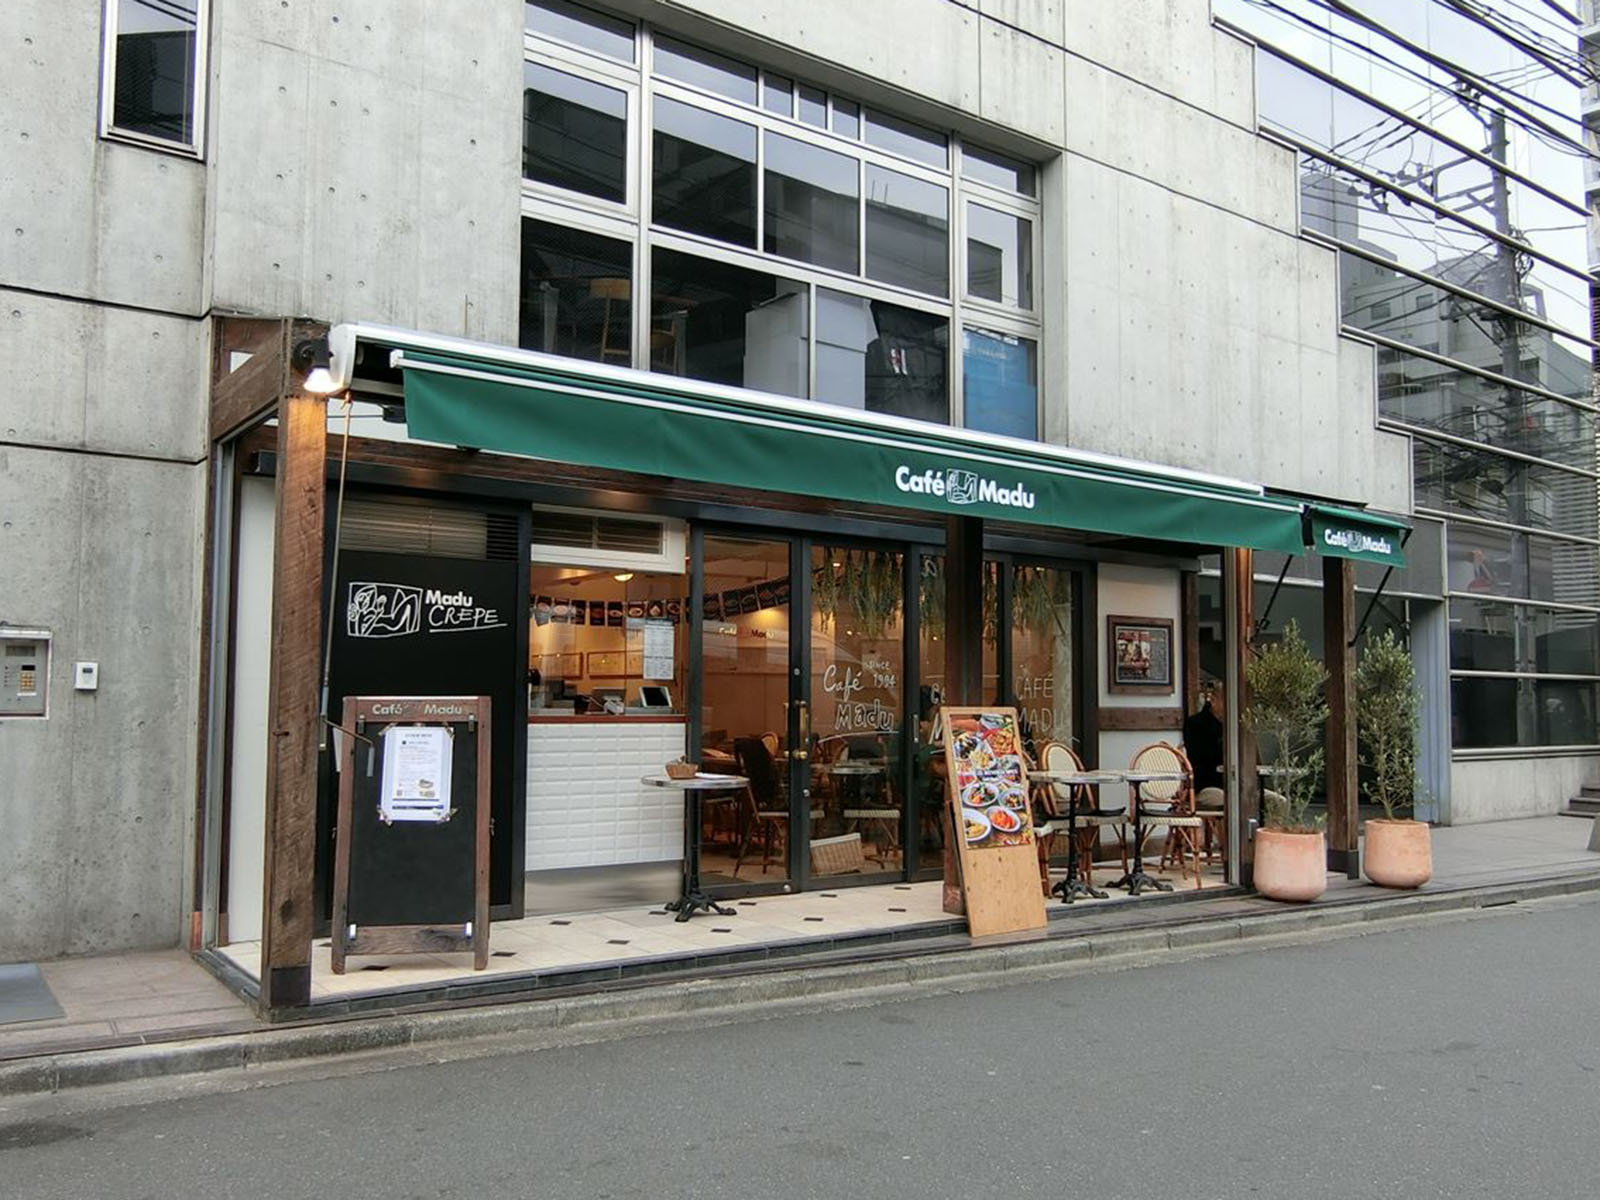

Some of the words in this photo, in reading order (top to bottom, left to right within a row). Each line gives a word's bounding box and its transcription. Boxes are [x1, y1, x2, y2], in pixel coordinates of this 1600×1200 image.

[895, 465, 945, 496] Café
[978, 479, 1035, 509] Madu
[1324, 528, 1348, 547] Café
[1362, 535, 1391, 554] Madu
[425, 589, 473, 607] Madu
[428, 605, 499, 628] CREPE
[823, 664, 864, 702] Café
[372, 703, 403, 715] Café
[424, 704, 463, 714] Madu
[835, 698, 895, 732] Madu
